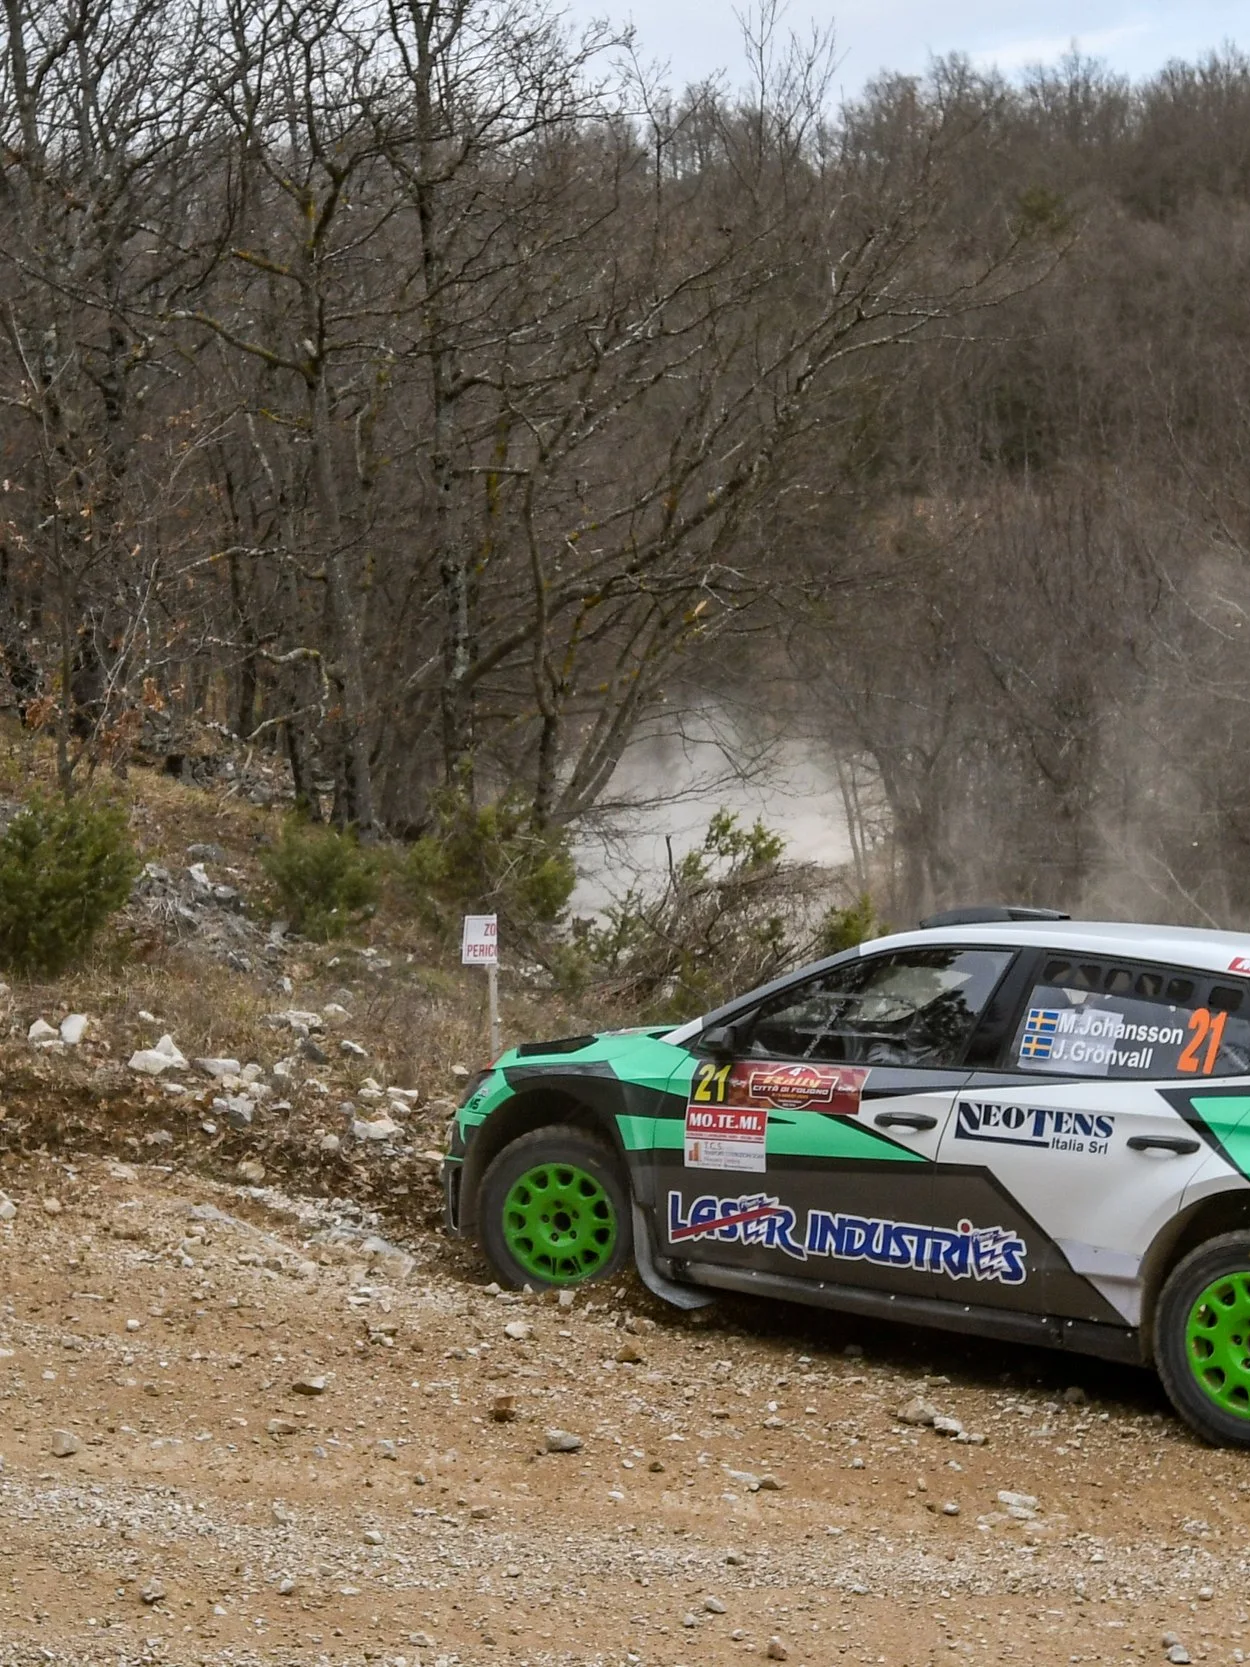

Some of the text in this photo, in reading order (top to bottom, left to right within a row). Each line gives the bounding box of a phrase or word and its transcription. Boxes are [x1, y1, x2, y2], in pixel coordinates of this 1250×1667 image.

[1058, 1013, 1184, 1045] M.Johansson
[1177, 1007, 1228, 1075] 21
[1052, 1040, 1153, 1069] J.Grönvall
[694, 1064, 732, 1102] 21
[689, 1112, 762, 1131] MO.TE.MI.
[956, 1102, 1115, 1139] NEOTENS
[1051, 1137, 1108, 1155] Italia Srl
